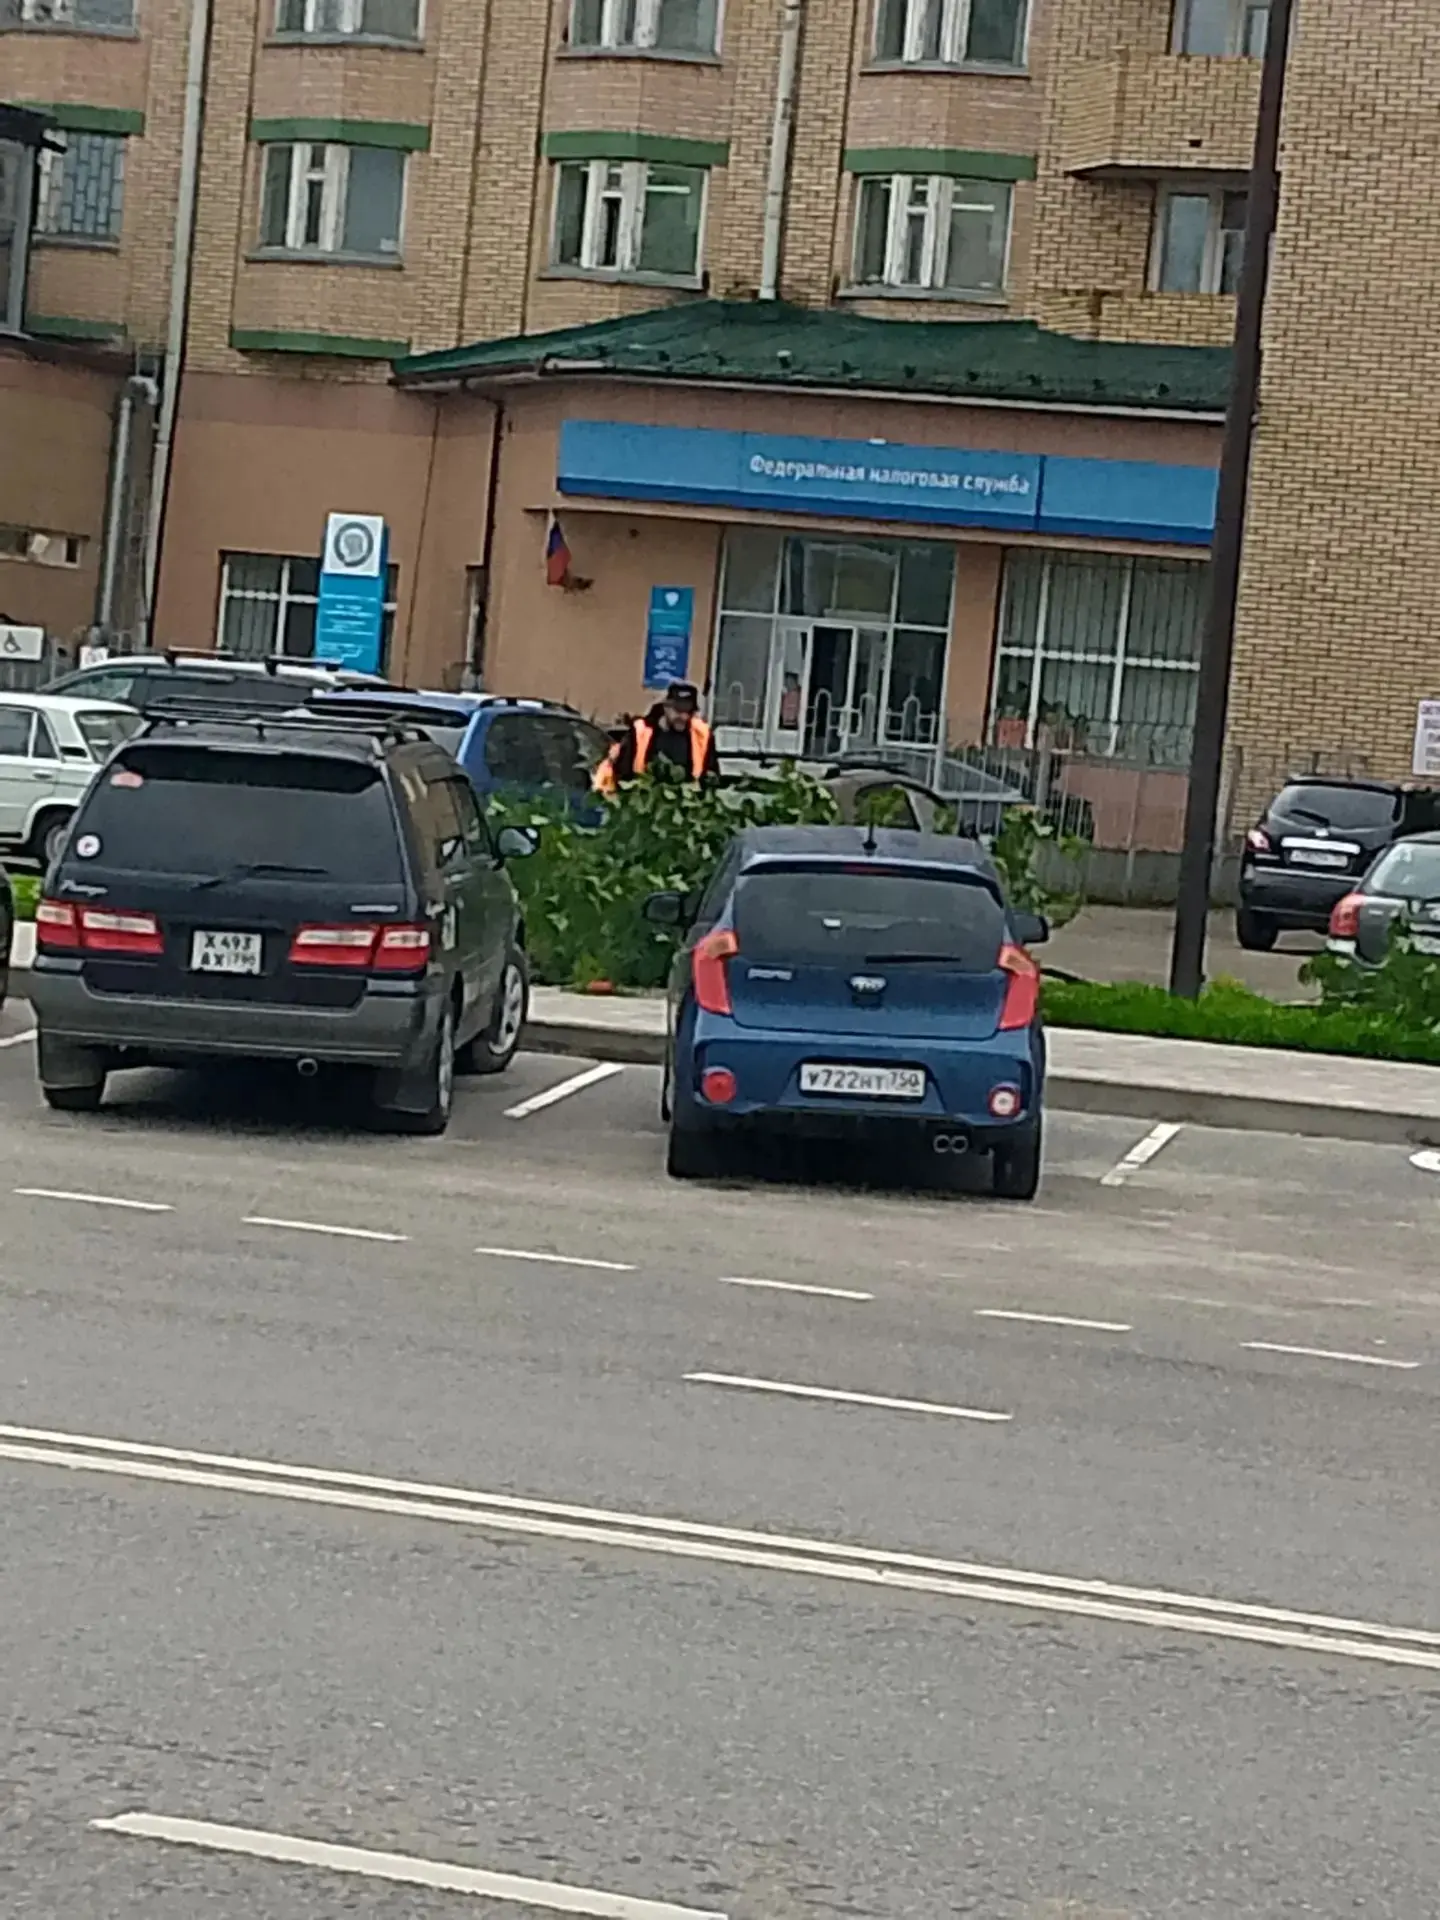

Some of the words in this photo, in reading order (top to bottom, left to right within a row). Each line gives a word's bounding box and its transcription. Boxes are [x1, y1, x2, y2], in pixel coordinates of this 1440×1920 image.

[750, 455, 866, 481] Федеральная
[868, 465, 960, 489] налоговая
[963, 475, 1031, 496] служба
